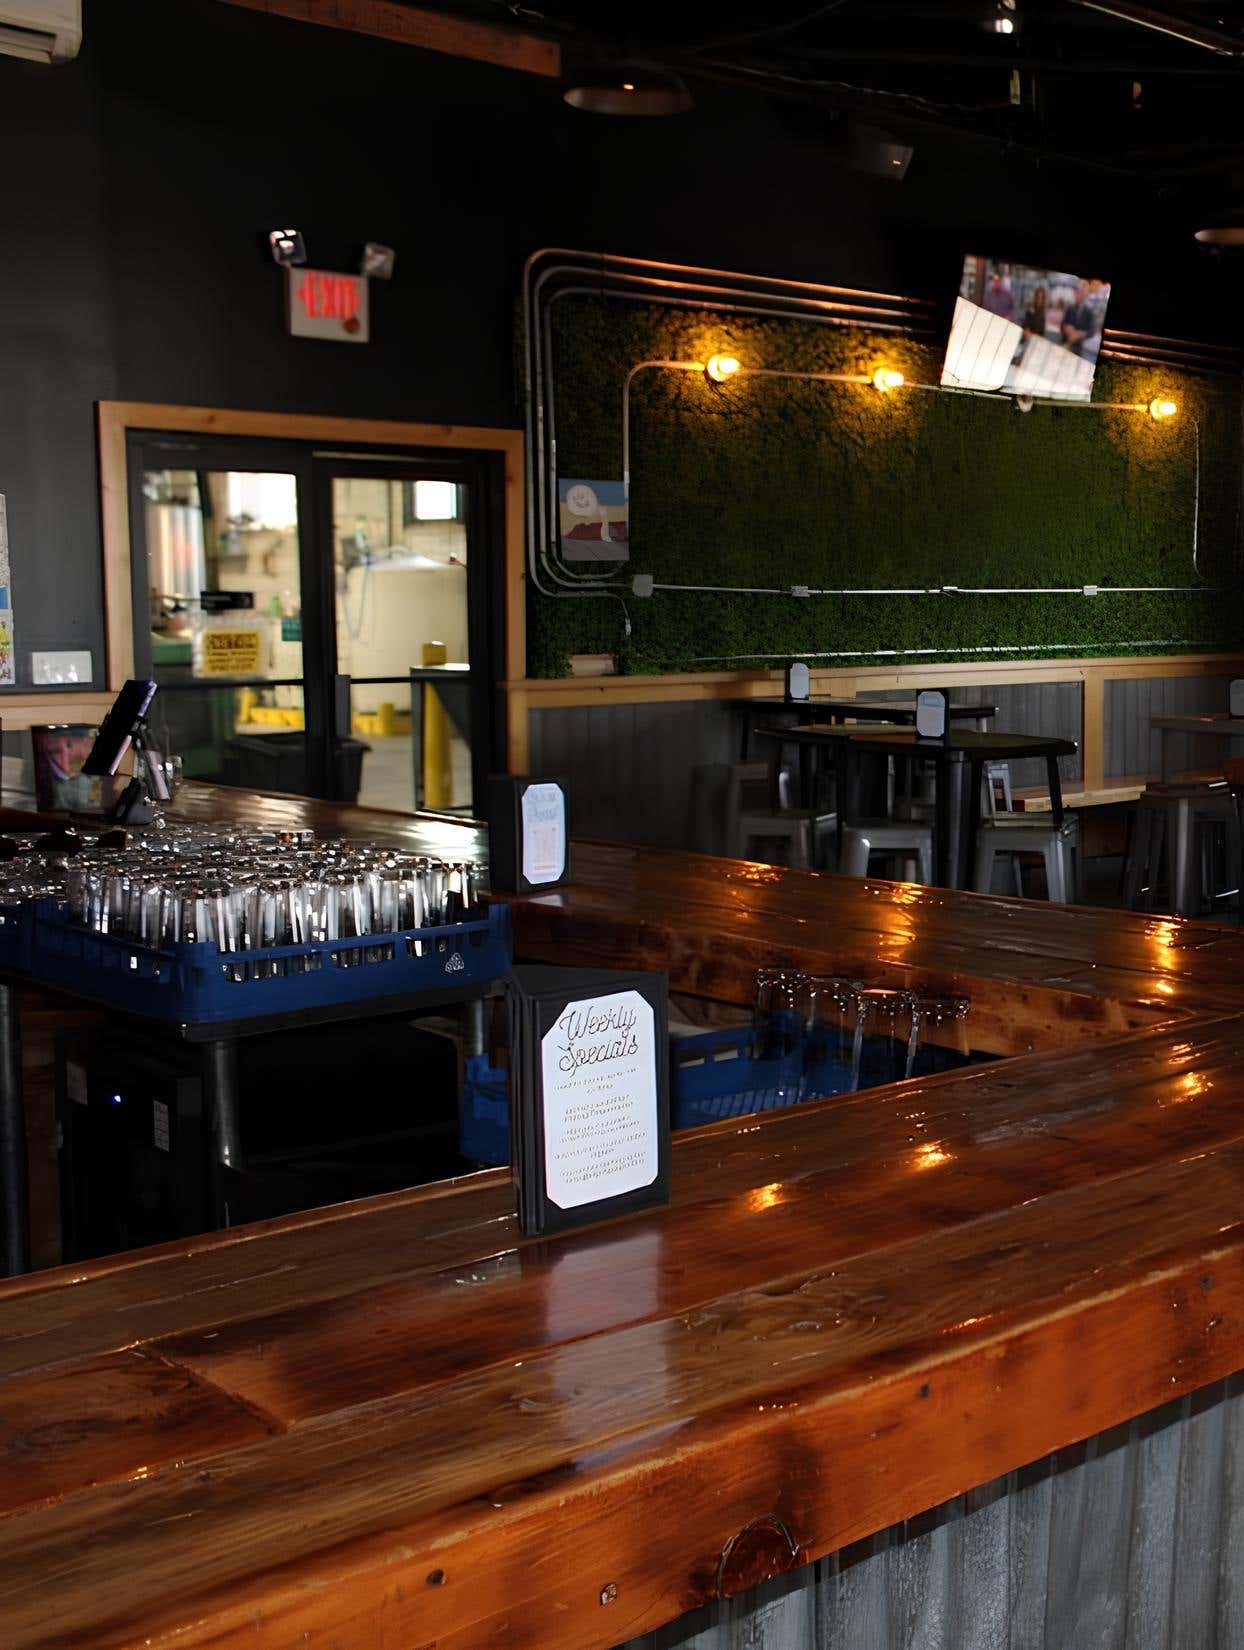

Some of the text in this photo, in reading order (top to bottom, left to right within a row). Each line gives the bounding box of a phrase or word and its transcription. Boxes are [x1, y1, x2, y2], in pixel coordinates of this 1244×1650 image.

[304, 271, 357, 319] EXIT
[559, 1005, 638, 1041] Weekly
[557, 1034, 639, 1078] Specials
